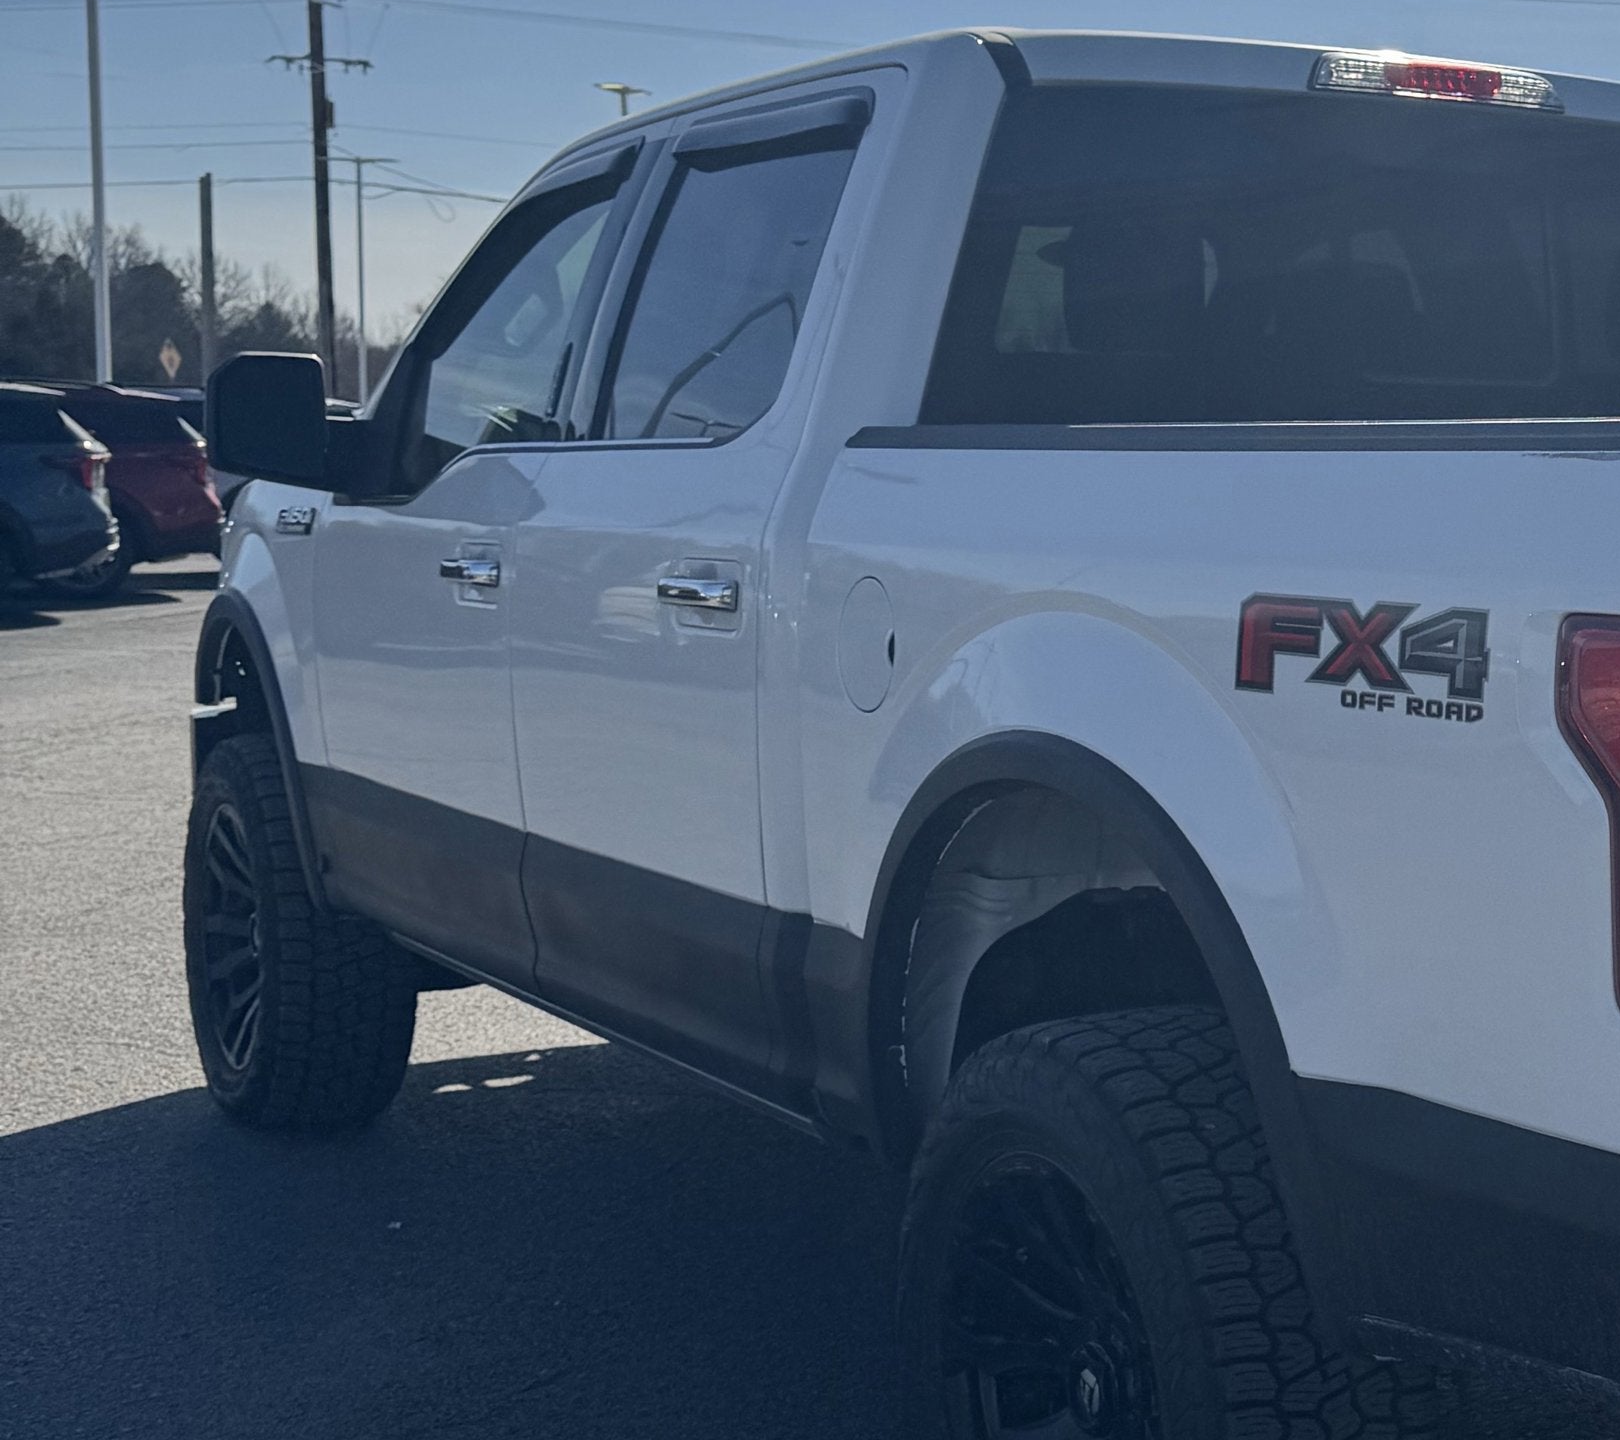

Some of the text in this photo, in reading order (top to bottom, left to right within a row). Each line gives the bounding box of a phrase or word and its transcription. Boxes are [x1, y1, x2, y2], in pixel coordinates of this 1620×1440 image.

[1234, 591, 1491, 703] FX4
[1340, 689, 1484, 723] OFF ROAD
